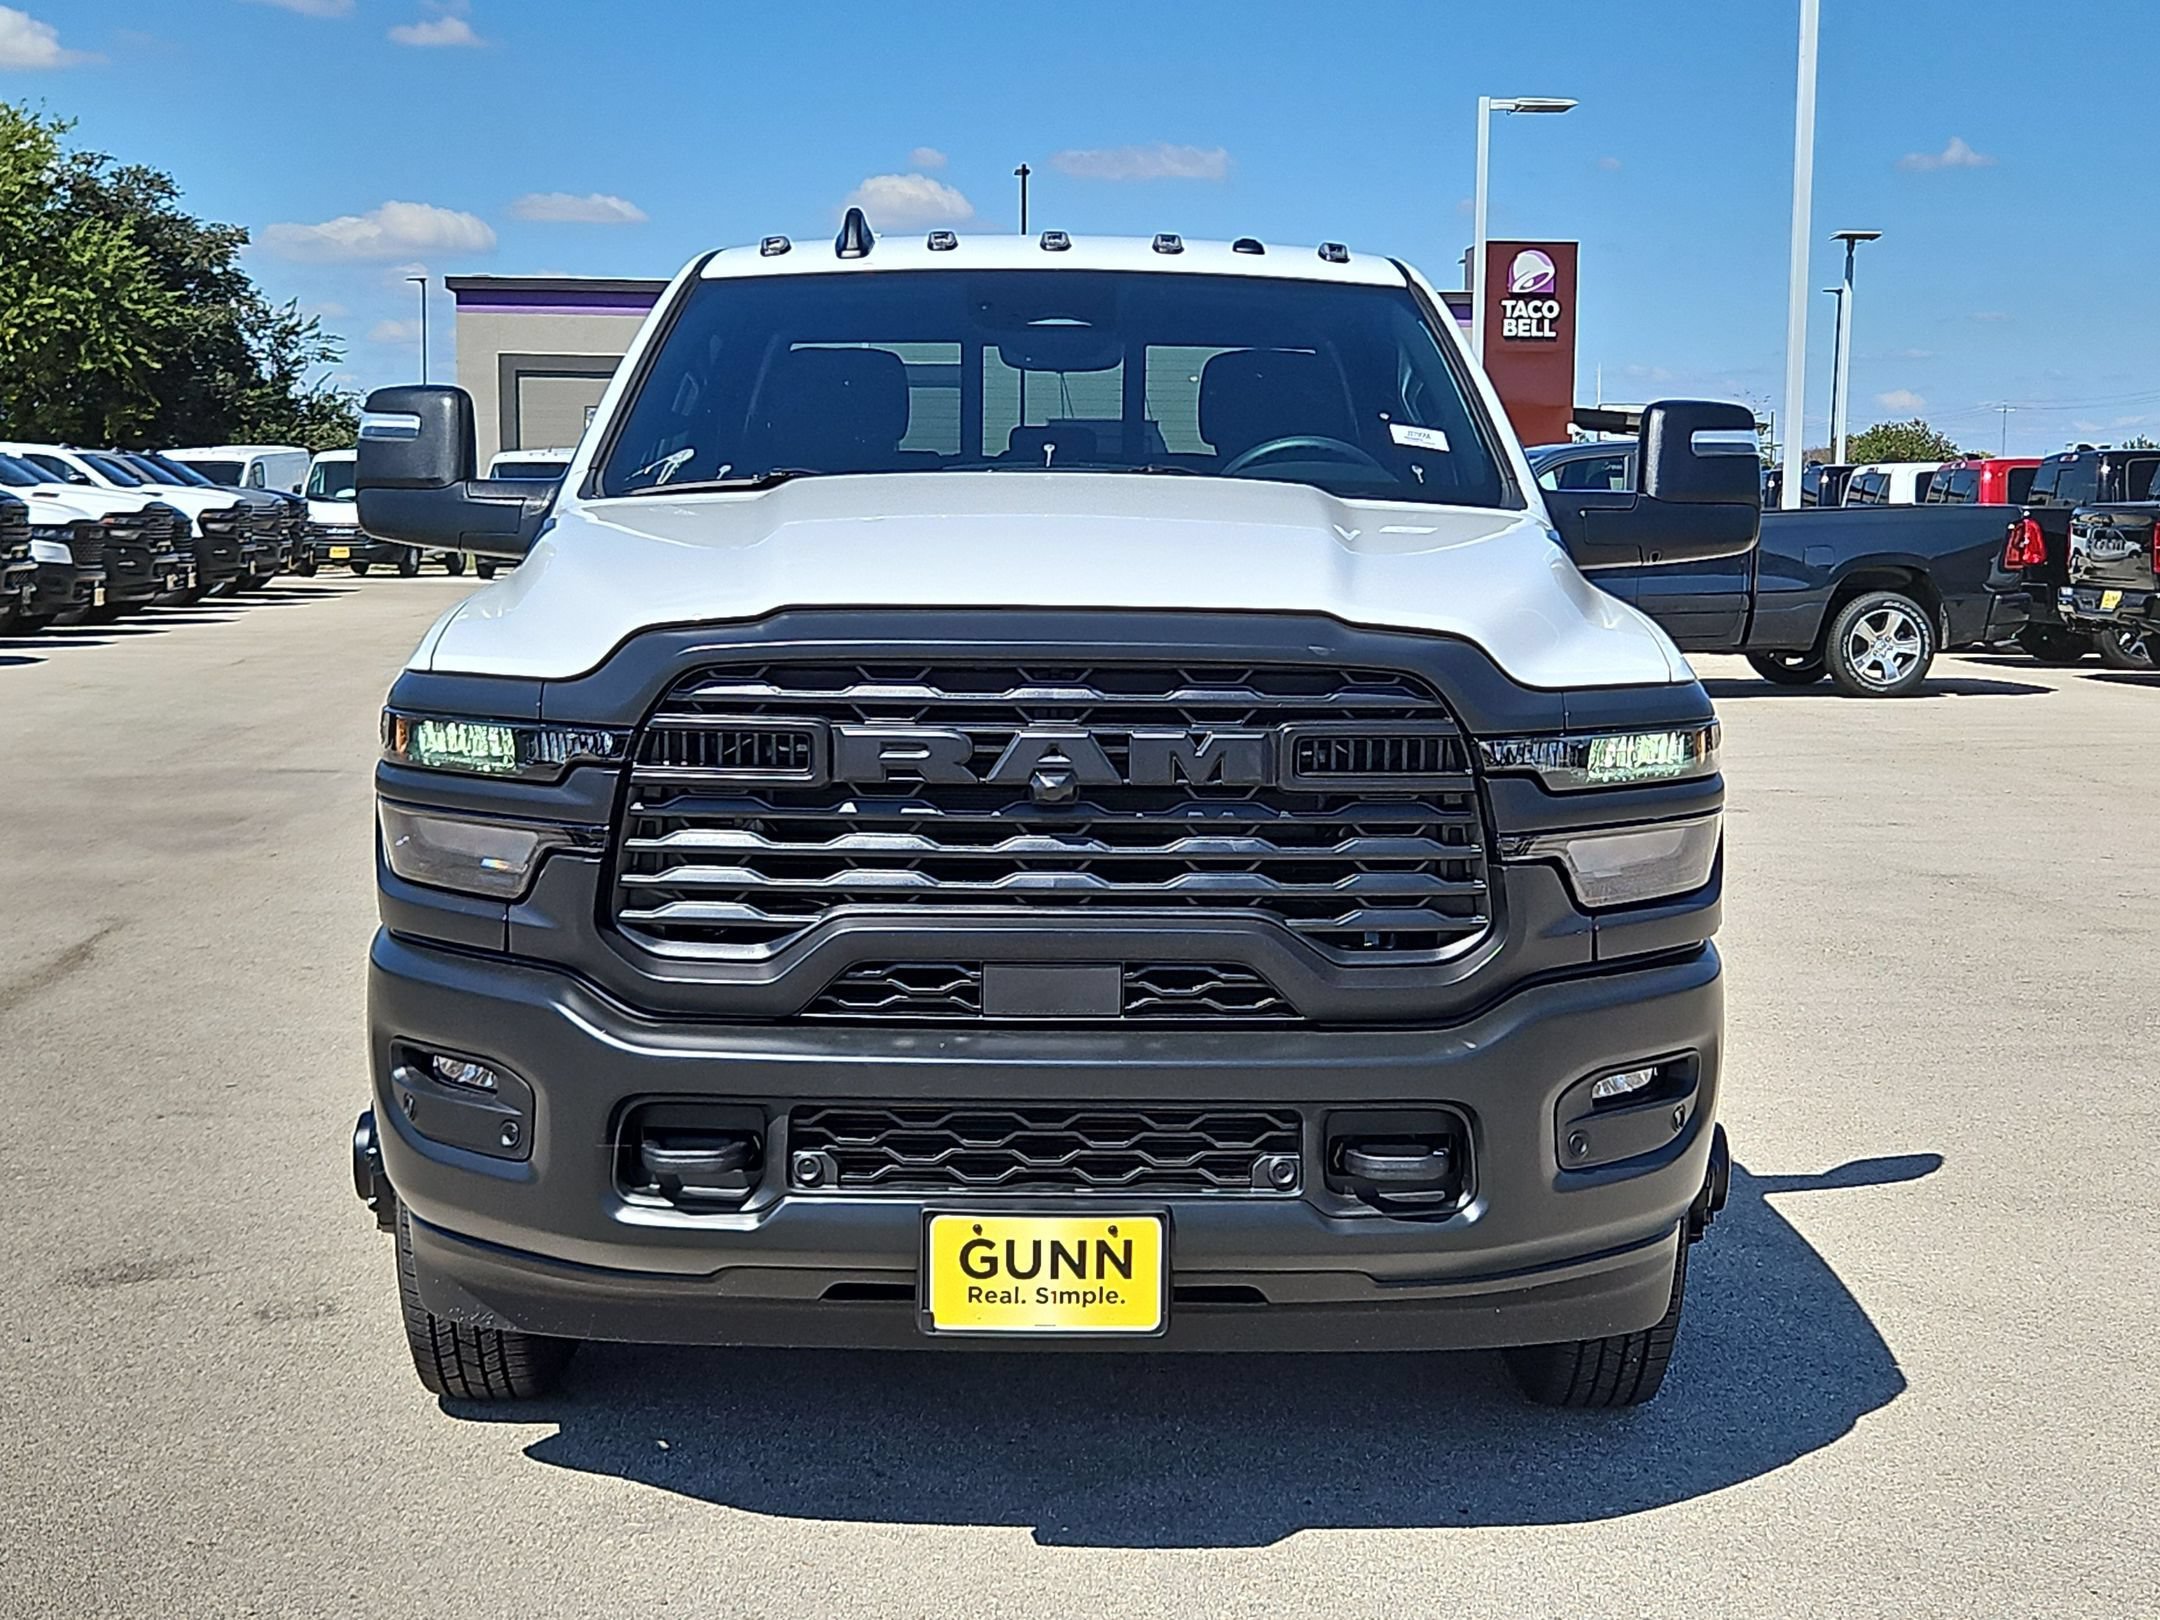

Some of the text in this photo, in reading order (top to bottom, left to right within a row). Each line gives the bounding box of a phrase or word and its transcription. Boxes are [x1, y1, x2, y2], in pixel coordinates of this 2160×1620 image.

[1501, 300, 1560, 318] TACO
[1503, 319, 1556, 337] BELL
[833, 726, 1268, 785] RAM
[959, 1238, 1132, 1280] GUNN
[968, 1286, 1026, 1304] Real.
